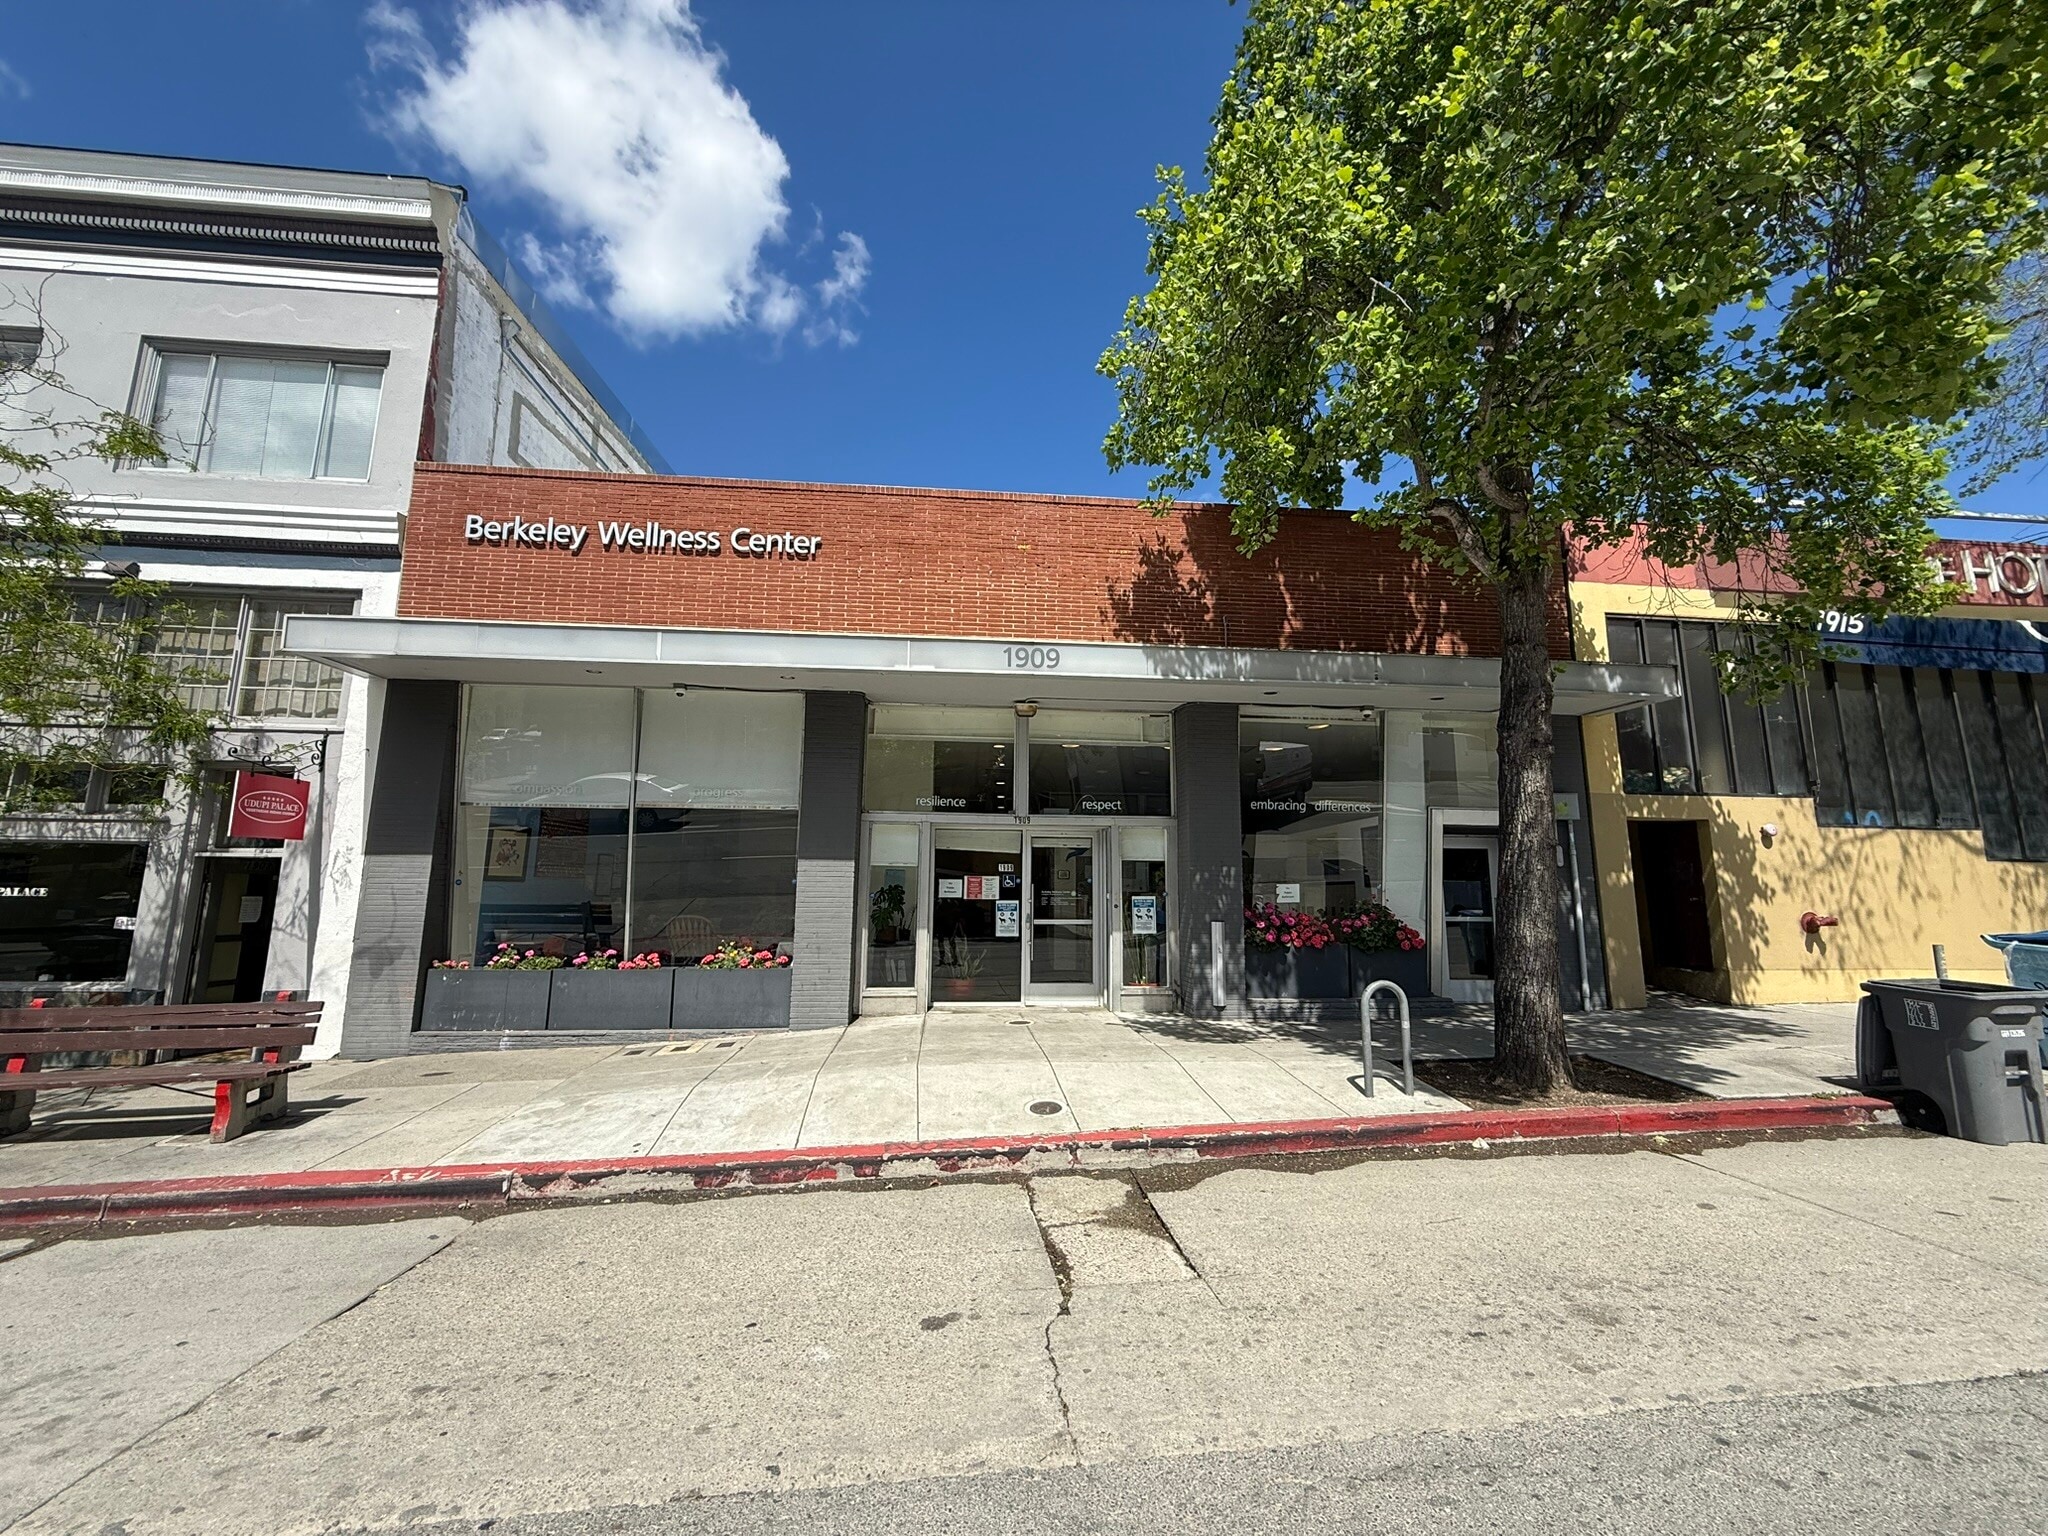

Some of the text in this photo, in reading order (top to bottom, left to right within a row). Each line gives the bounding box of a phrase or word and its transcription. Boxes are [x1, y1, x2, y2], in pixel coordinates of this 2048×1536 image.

[464, 514, 822, 554] Berkeley Wellness Center
[1003, 647, 1060, 669] 1909
[244, 799, 300, 812] UDUPI PALACE
[916, 795, 966, 807] resilience
[1082, 800, 1122, 812] respect
[1250, 798, 1371, 813] embracing differences
[0, 887, 49, 897] PALACE
